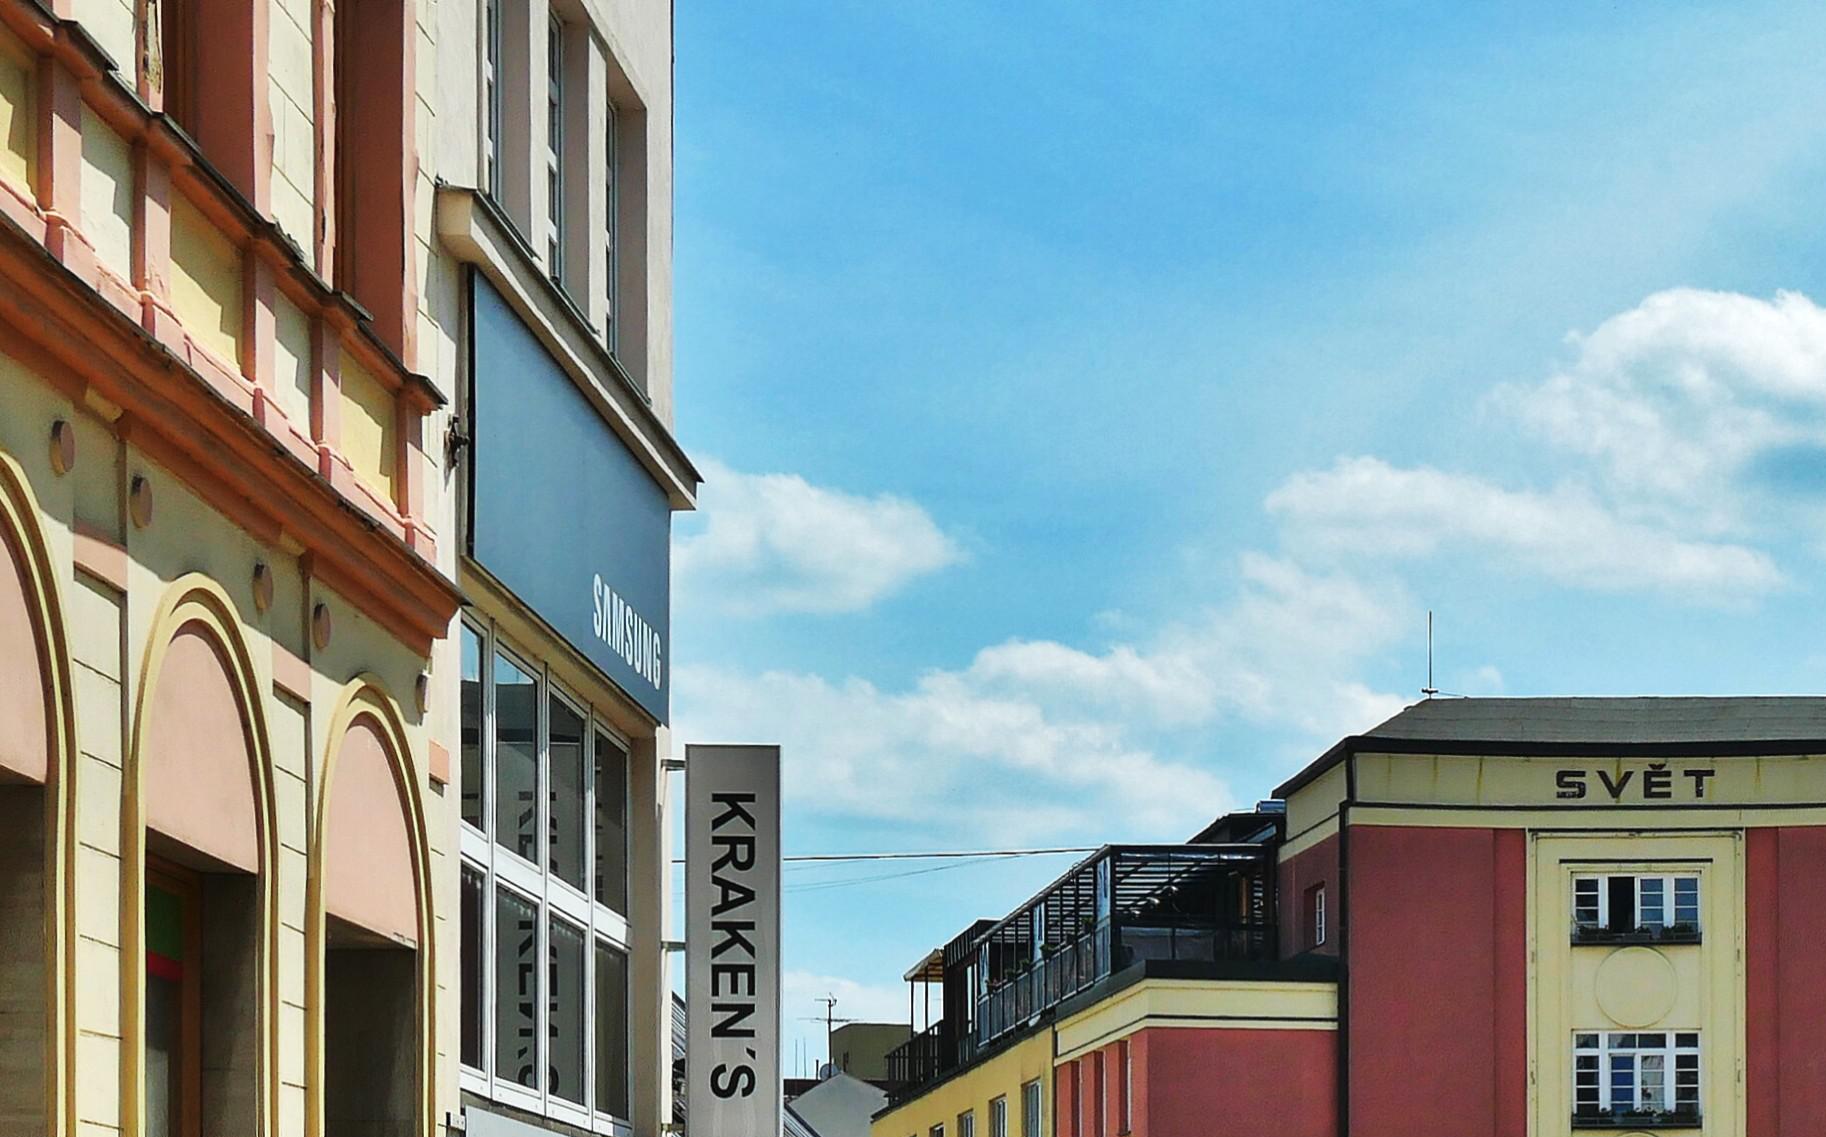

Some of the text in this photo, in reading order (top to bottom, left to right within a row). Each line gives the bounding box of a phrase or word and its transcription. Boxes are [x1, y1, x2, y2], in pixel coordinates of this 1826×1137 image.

[592, 573, 662, 691] SAMSUNG
[1556, 763, 1716, 799] SVĚT
[710, 792, 757, 1100] KRAKEN'S
